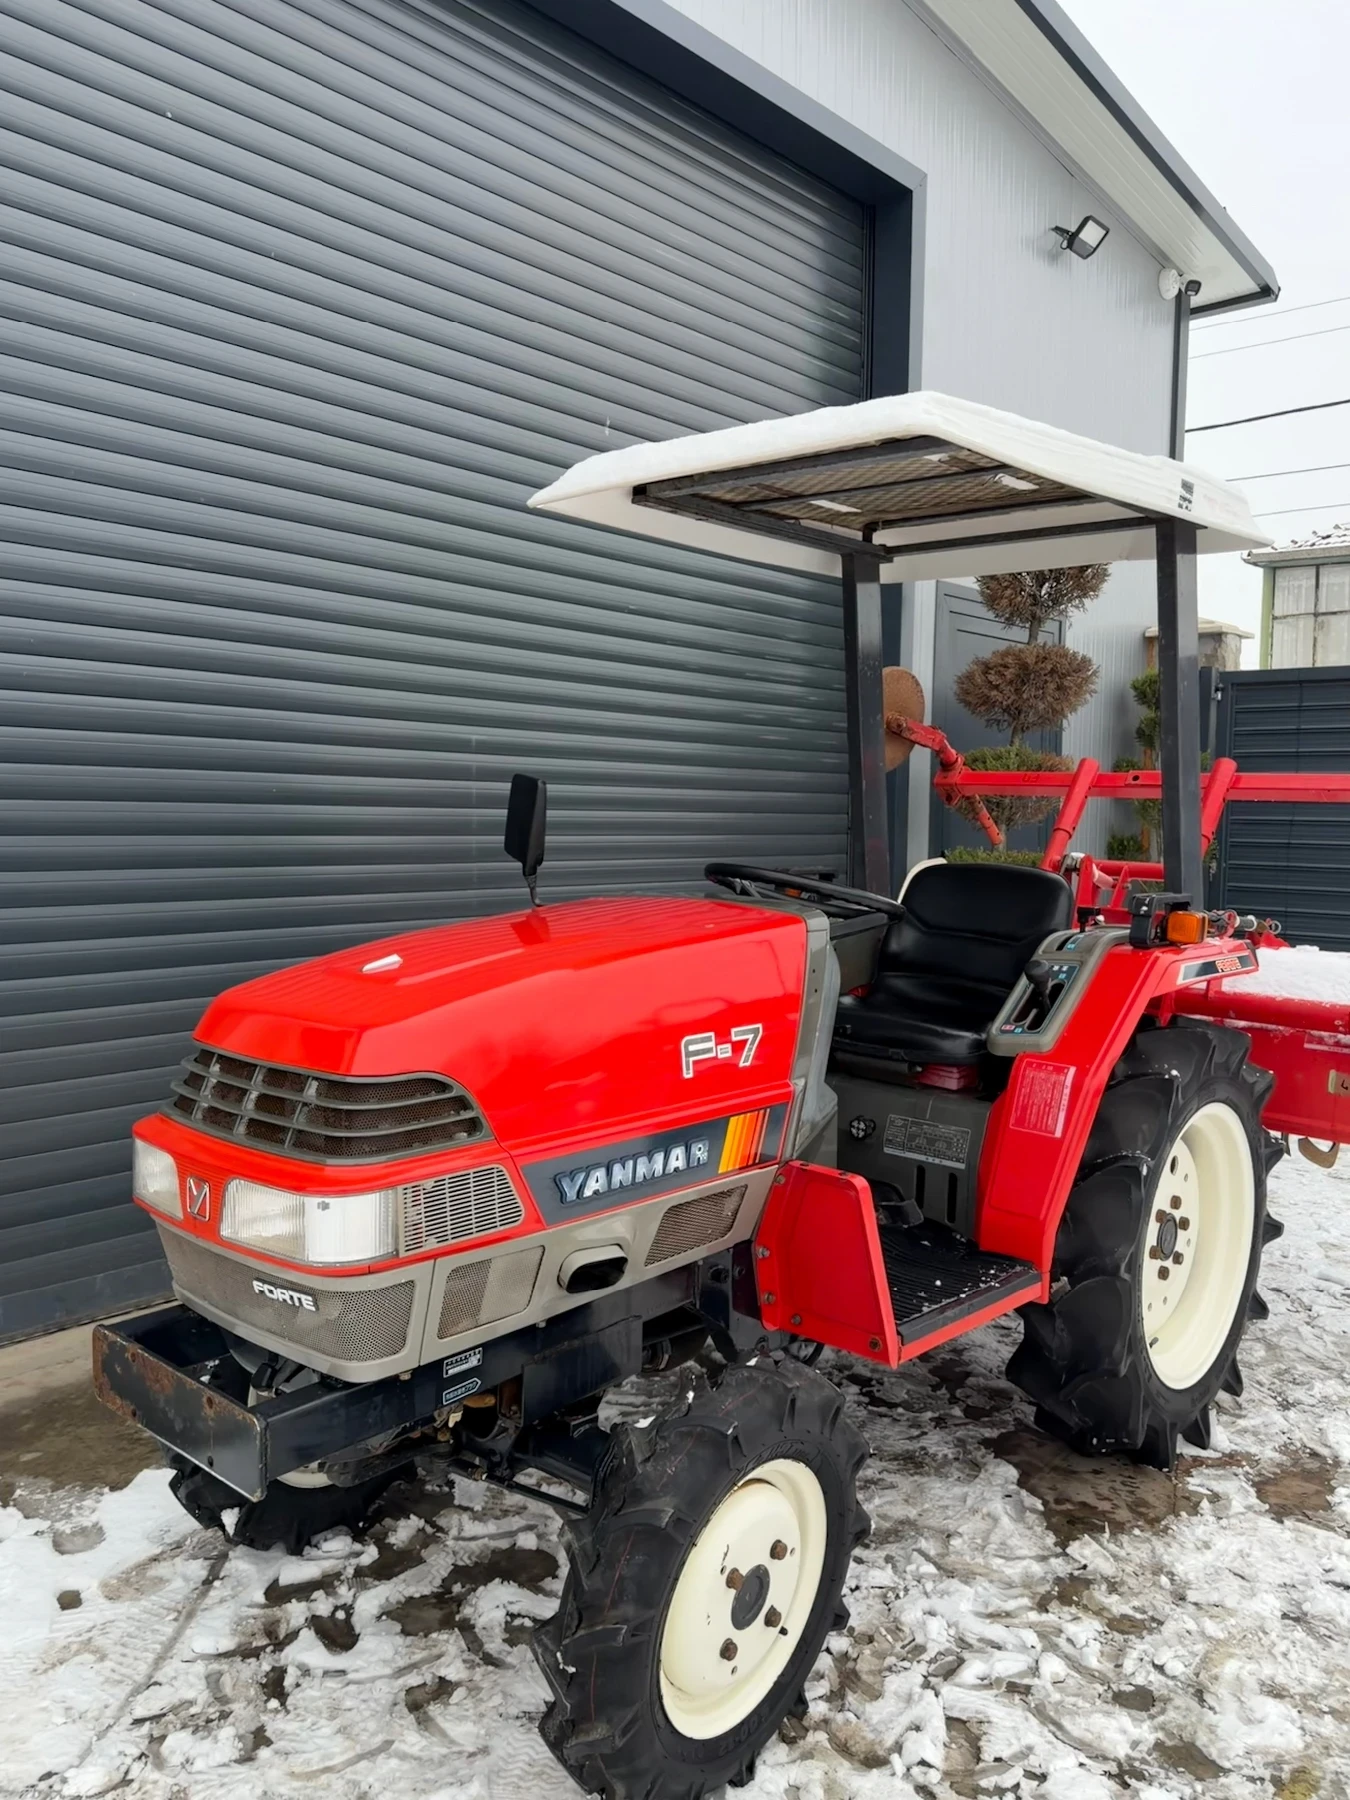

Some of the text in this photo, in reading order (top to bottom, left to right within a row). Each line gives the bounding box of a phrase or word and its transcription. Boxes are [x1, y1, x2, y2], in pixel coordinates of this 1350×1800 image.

[681, 1023, 763, 1079] F-7
[557, 1138, 710, 1204] YANMAR
[252, 1279, 317, 1312] FORTE
